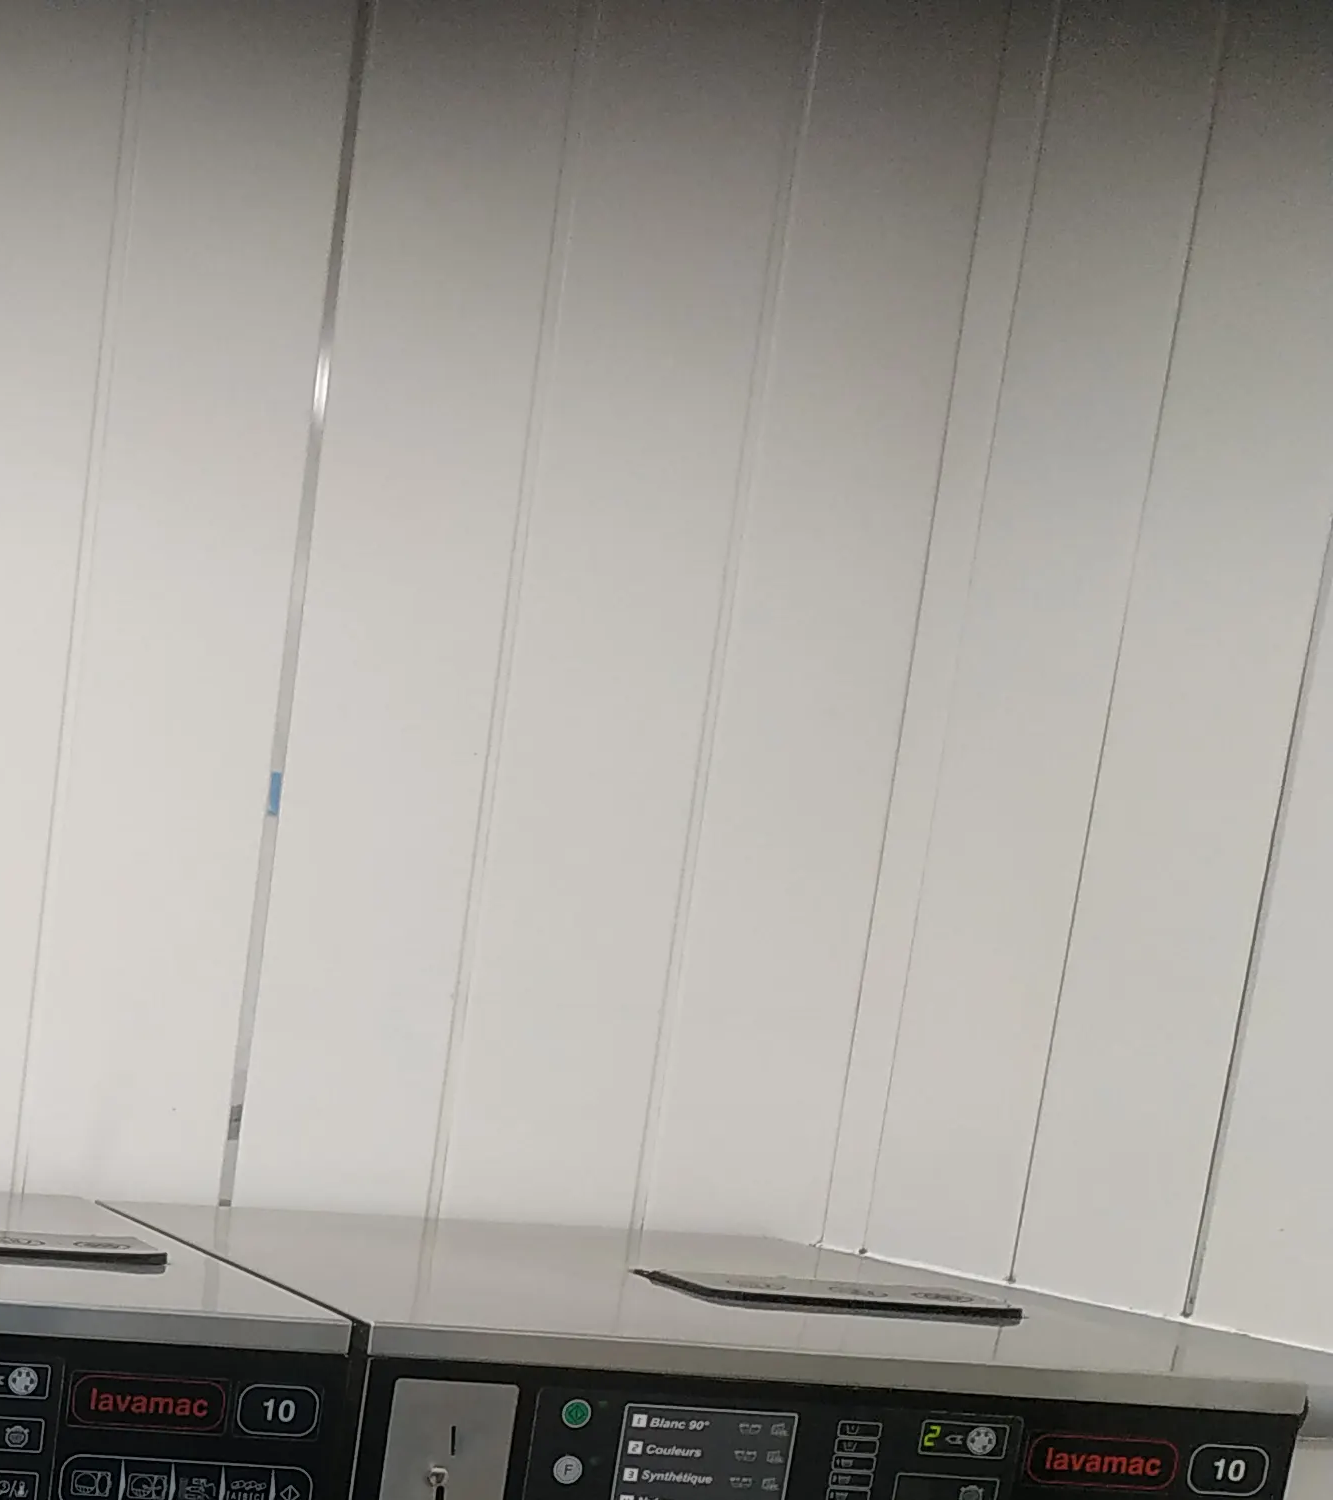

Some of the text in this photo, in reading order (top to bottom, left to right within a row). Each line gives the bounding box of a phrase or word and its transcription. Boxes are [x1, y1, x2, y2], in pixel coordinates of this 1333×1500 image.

[90, 1387, 208, 1417] lavamac
[263, 1399, 296, 1423] 10
[650, 1417, 686, 1430] Blanc
[923, 1425, 942, 1447] 2
[645, 1445, 702, 1458] Couleurs
[1045, 1447, 1162, 1477] lavamac
[563, 1464, 574, 1475] F
[641, 1469, 713, 1486] Synthétique
[1213, 1459, 1246, 1482] 10
